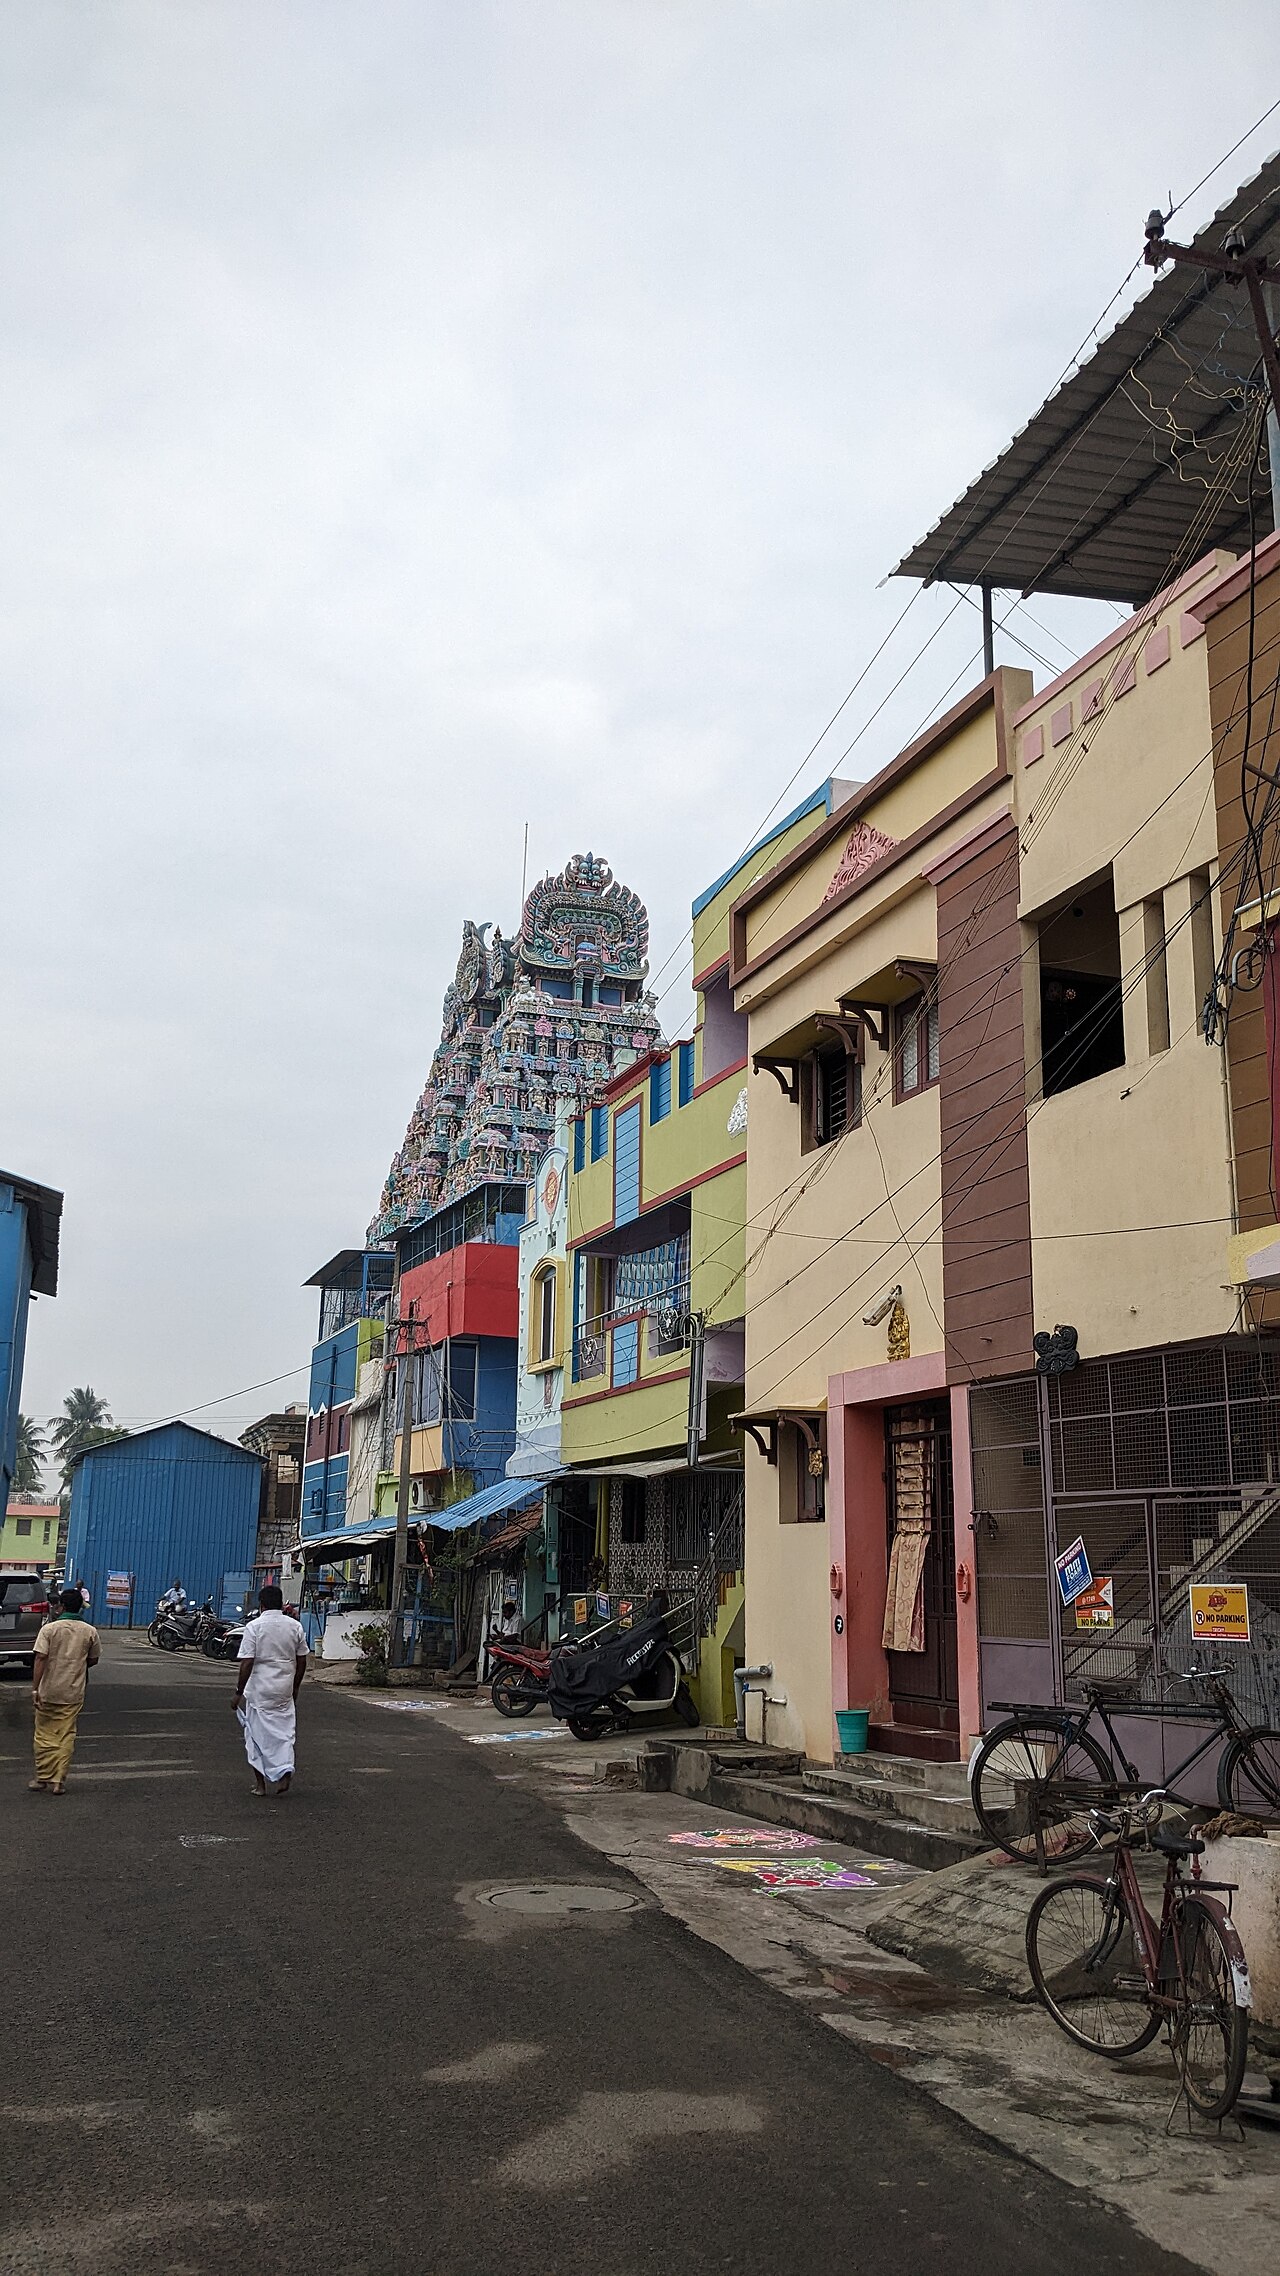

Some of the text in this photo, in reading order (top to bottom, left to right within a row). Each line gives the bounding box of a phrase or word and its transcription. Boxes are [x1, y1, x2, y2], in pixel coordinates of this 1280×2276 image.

[1058, 1542, 1082, 1569] NO PARKING
[1066, 1565, 1083, 1583] FOAM
[1081, 1618, 1089, 1627] NO
[1206, 1614, 1245, 1623] NO PARKING
